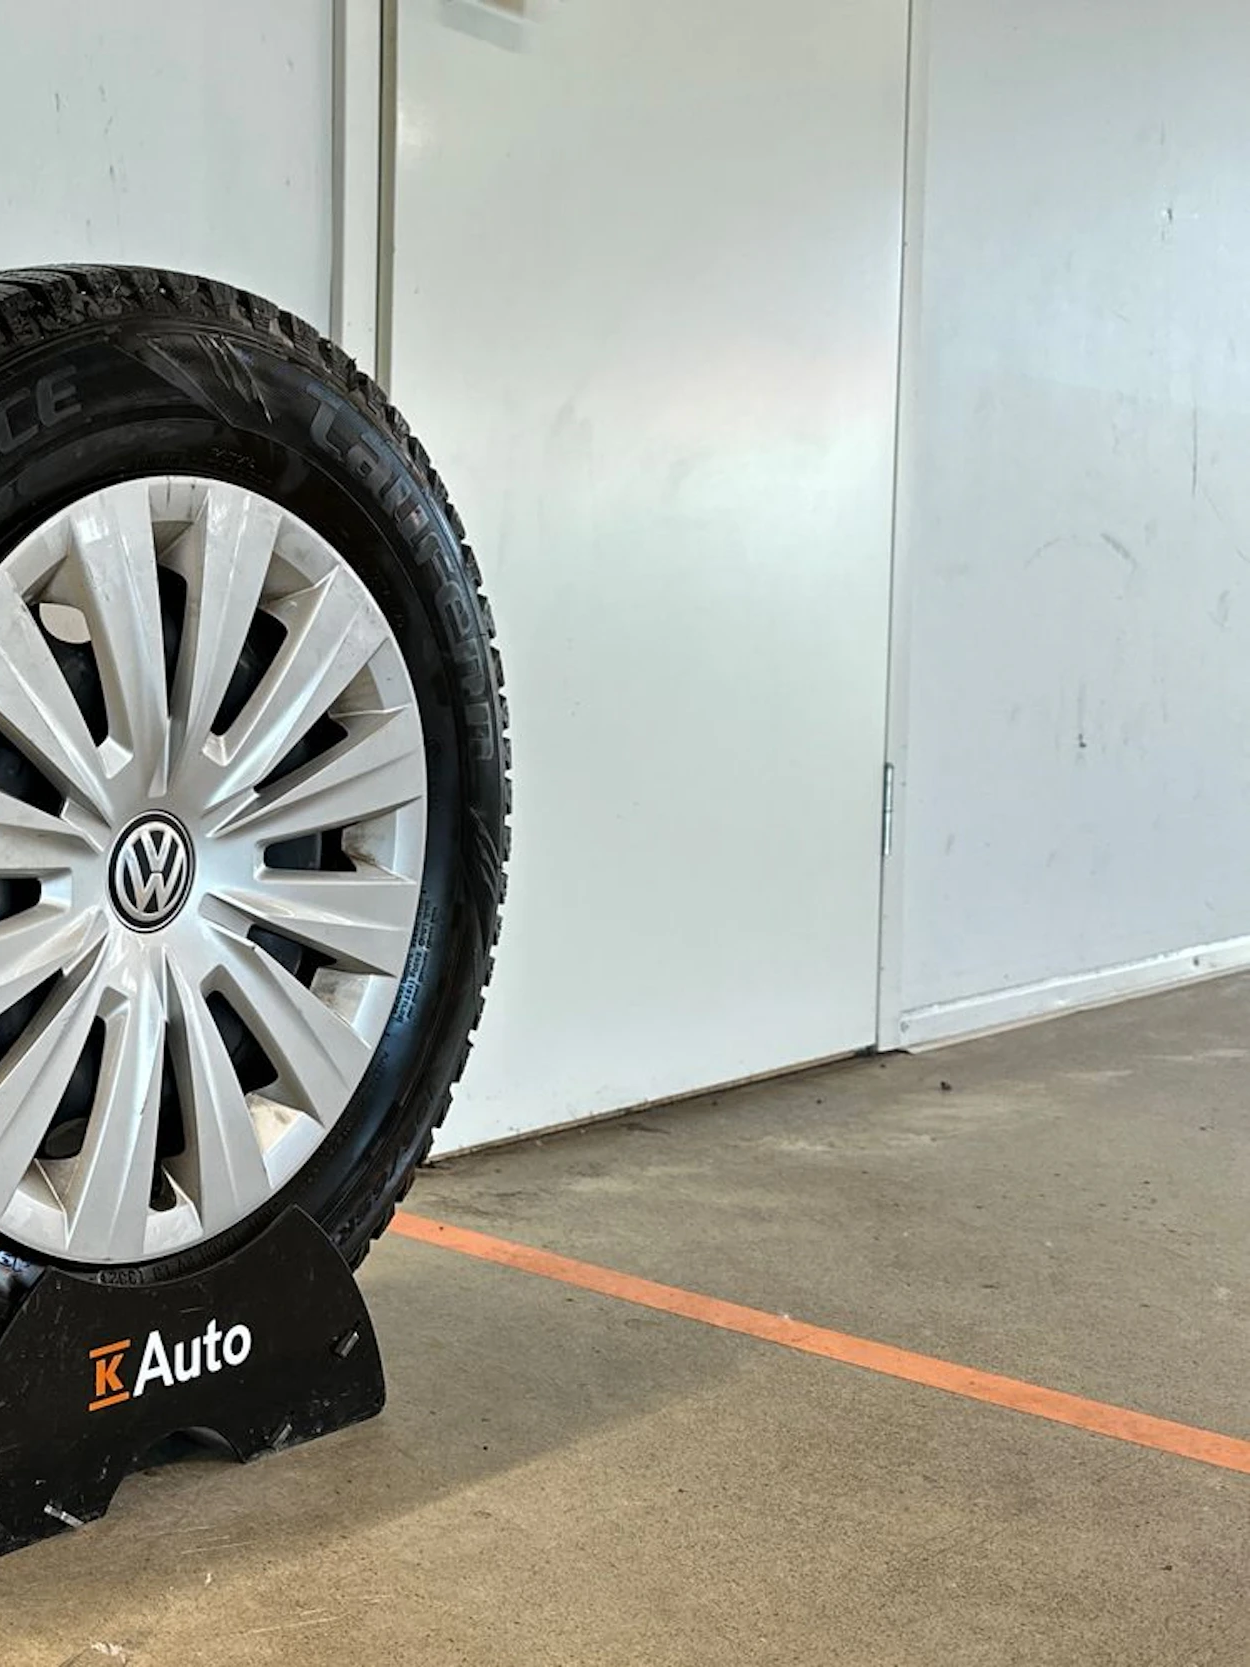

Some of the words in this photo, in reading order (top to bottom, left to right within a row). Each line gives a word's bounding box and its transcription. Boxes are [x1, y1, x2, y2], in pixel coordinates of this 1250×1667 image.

[113, 819, 189, 923] VW
[93, 1348, 127, 1400] K
[132, 1317, 253, 1399] Auto
